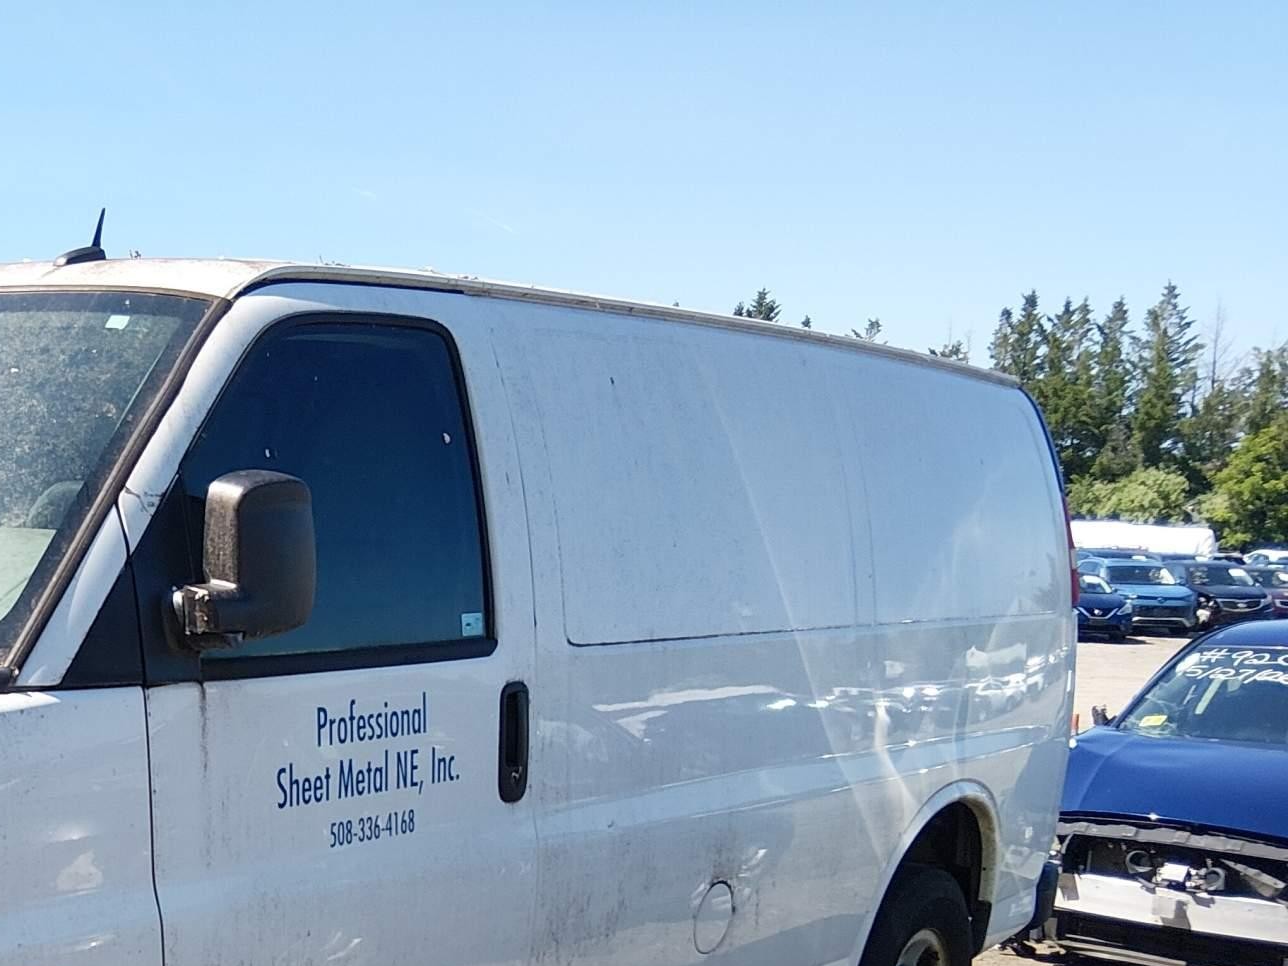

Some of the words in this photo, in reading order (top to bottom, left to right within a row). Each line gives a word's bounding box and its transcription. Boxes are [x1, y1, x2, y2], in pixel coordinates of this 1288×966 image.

[317, 692, 427, 747] Professional
[276, 762, 331, 809] Sheet
[338, 750, 389, 799] Metal
[396, 749, 424, 795] NE,
[431, 746, 460, 784] Inc.
[329, 809, 415, 848] 508-336-4168
